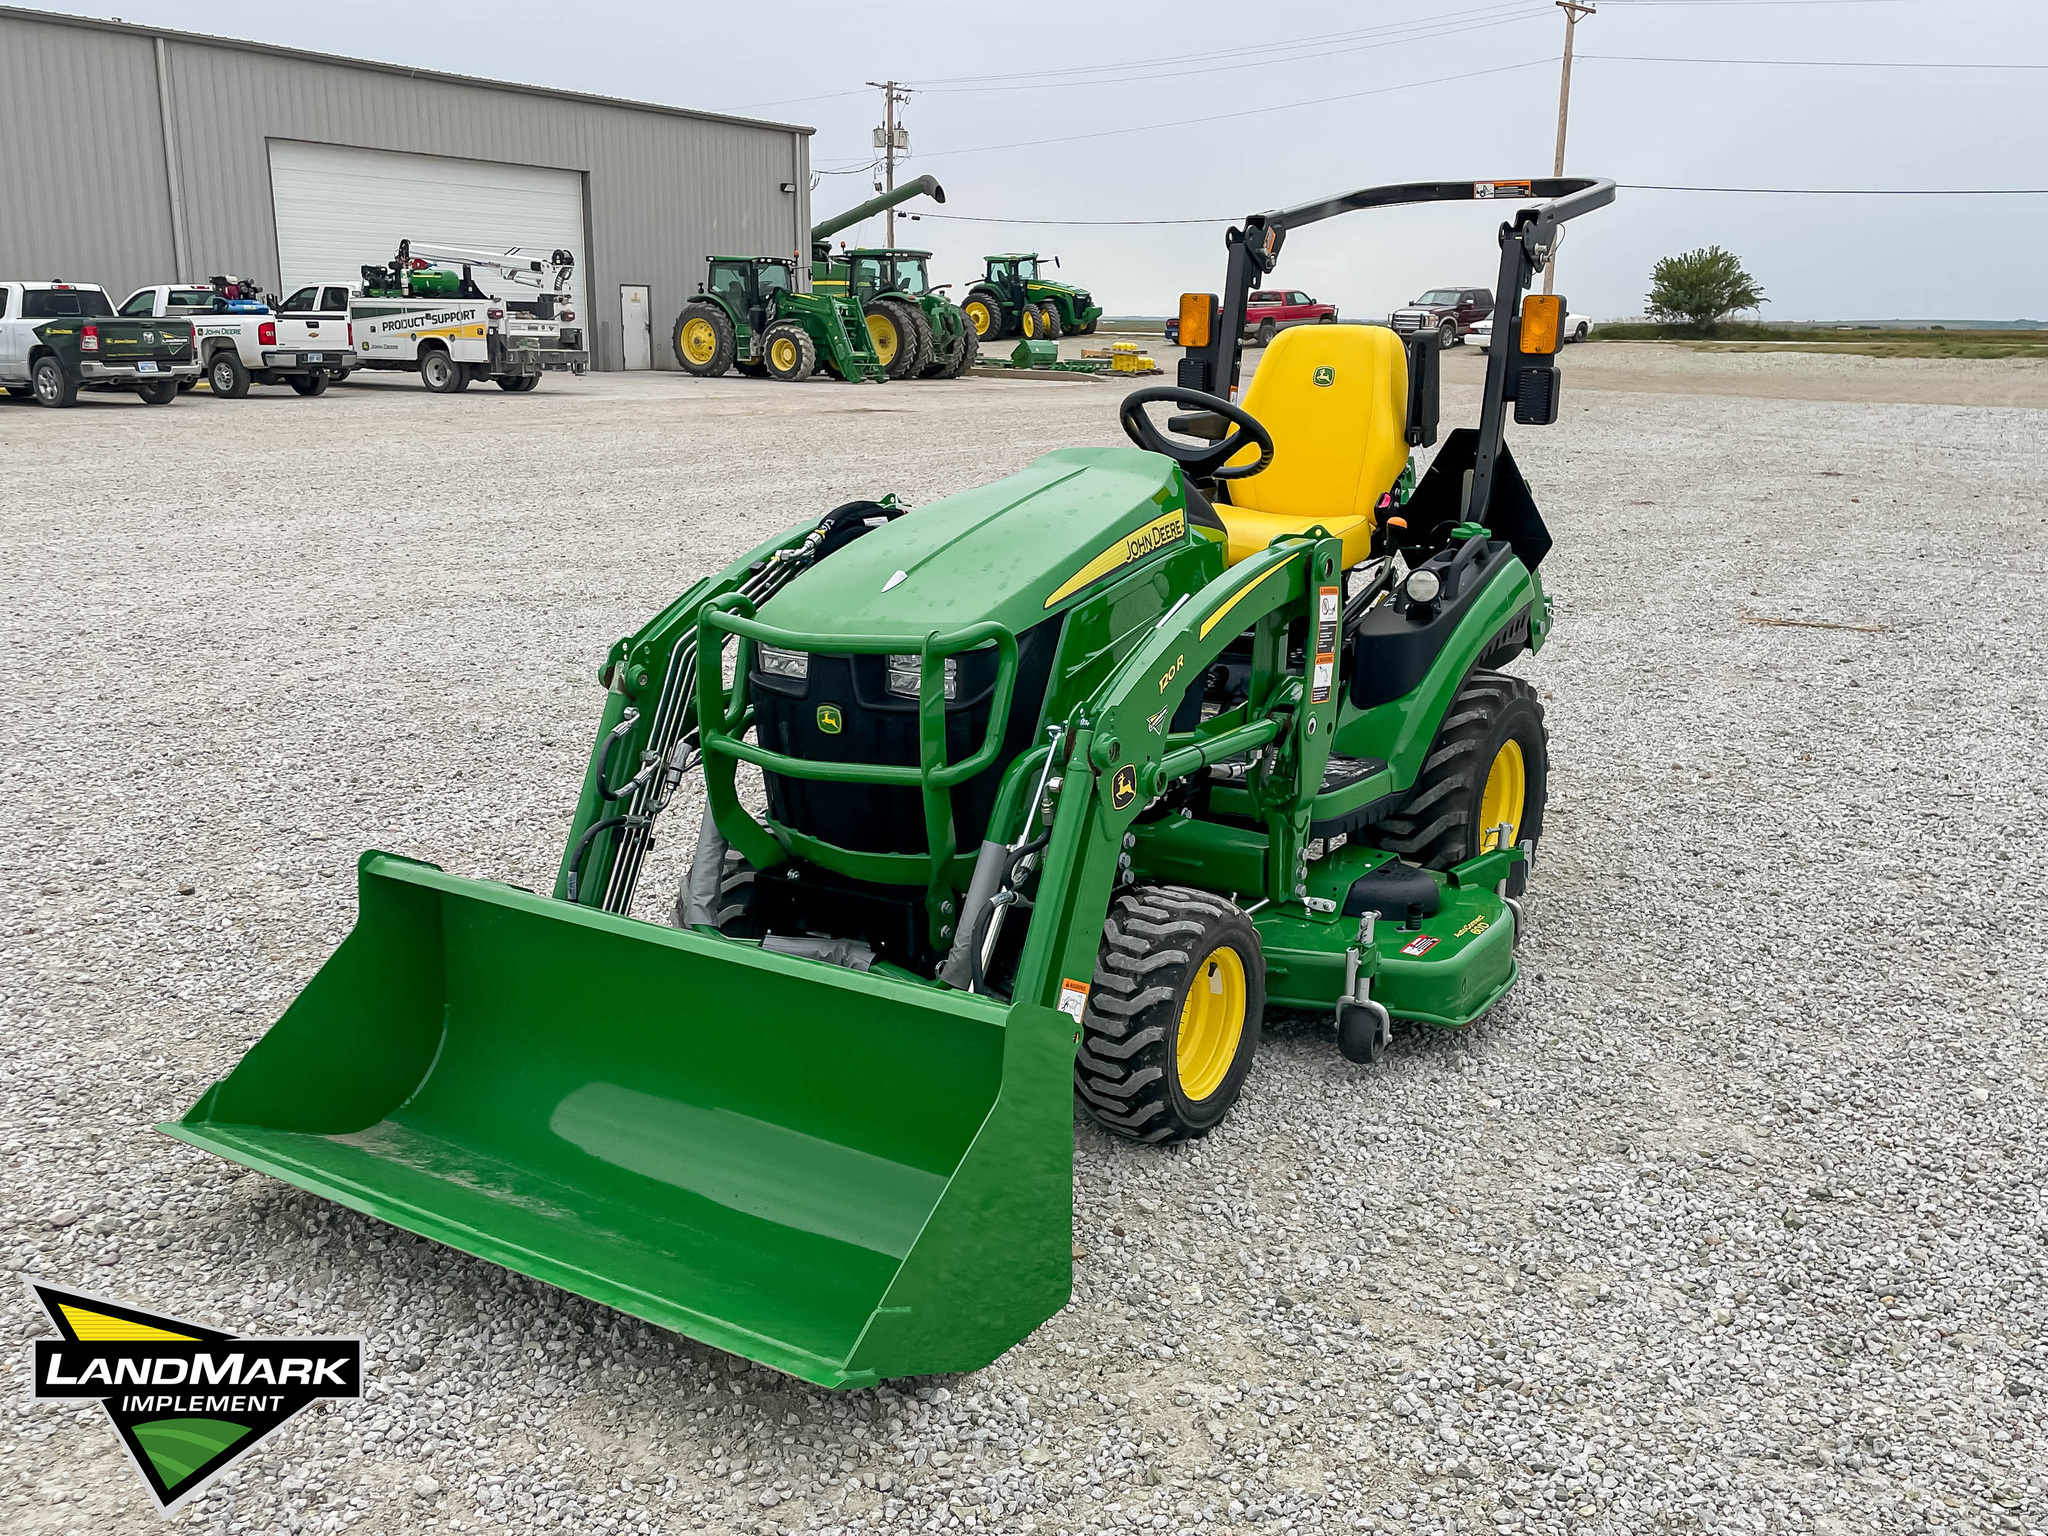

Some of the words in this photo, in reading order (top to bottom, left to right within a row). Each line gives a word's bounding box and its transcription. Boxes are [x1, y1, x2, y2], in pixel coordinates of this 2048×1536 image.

[204, 328, 220, 336] JOHN
[382, 316, 426, 332] PRODUCT
[431, 309, 476, 325] SUPPORT
[1126, 532, 1152, 561] JOHN
[1152, 520, 1182, 546] DEERE
